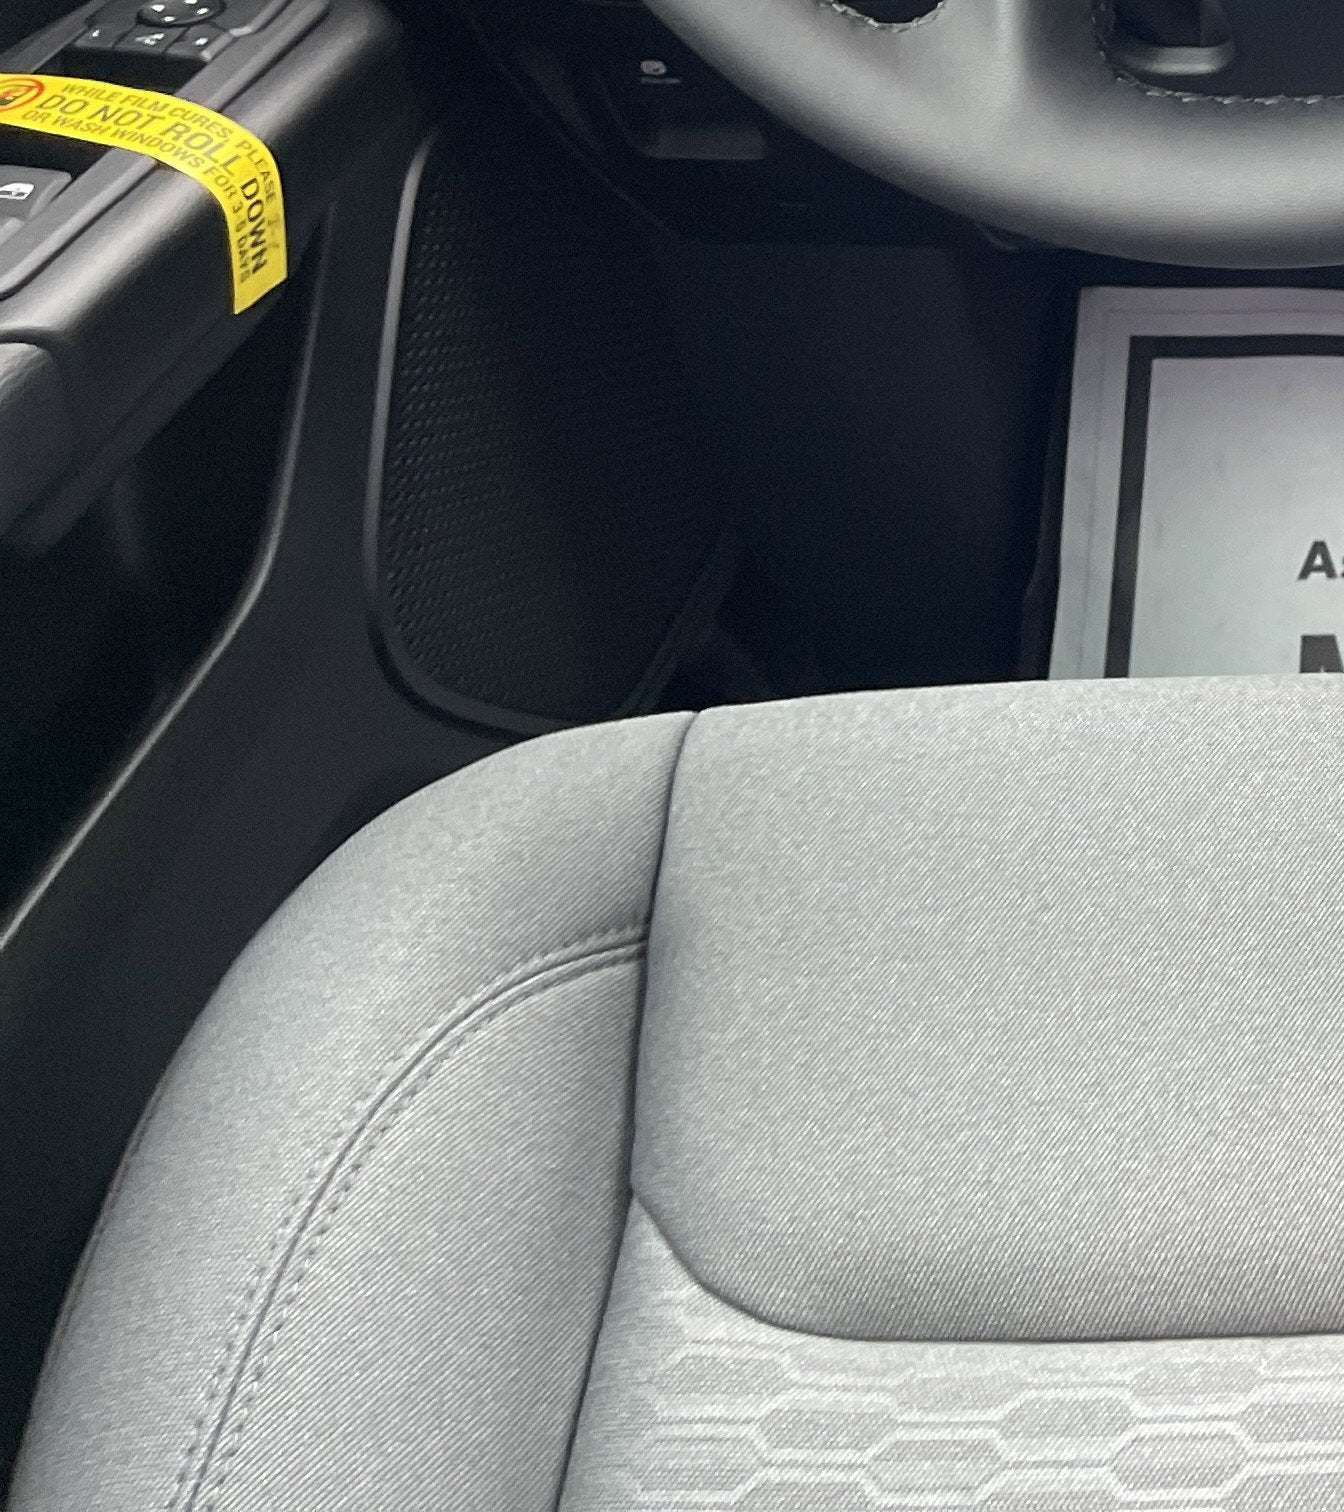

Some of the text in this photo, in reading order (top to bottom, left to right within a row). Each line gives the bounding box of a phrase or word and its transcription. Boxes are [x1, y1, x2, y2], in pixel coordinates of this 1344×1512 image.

[21, 110, 52, 124] OR
[52, 114, 111, 136] WASH
[111, 128, 206, 170] WINDOWS
[203, 165, 237, 200] FOR
[36, 94, 89, 113] DO
[94, 104, 167, 131] NOT
[160, 122, 241, 177] ROLL
[240, 177, 268, 275] DOWN
[62, 83, 123, 104] WHILE
[119, 94, 170, 113] FILM
[235, 138, 278, 203] PLEASE
